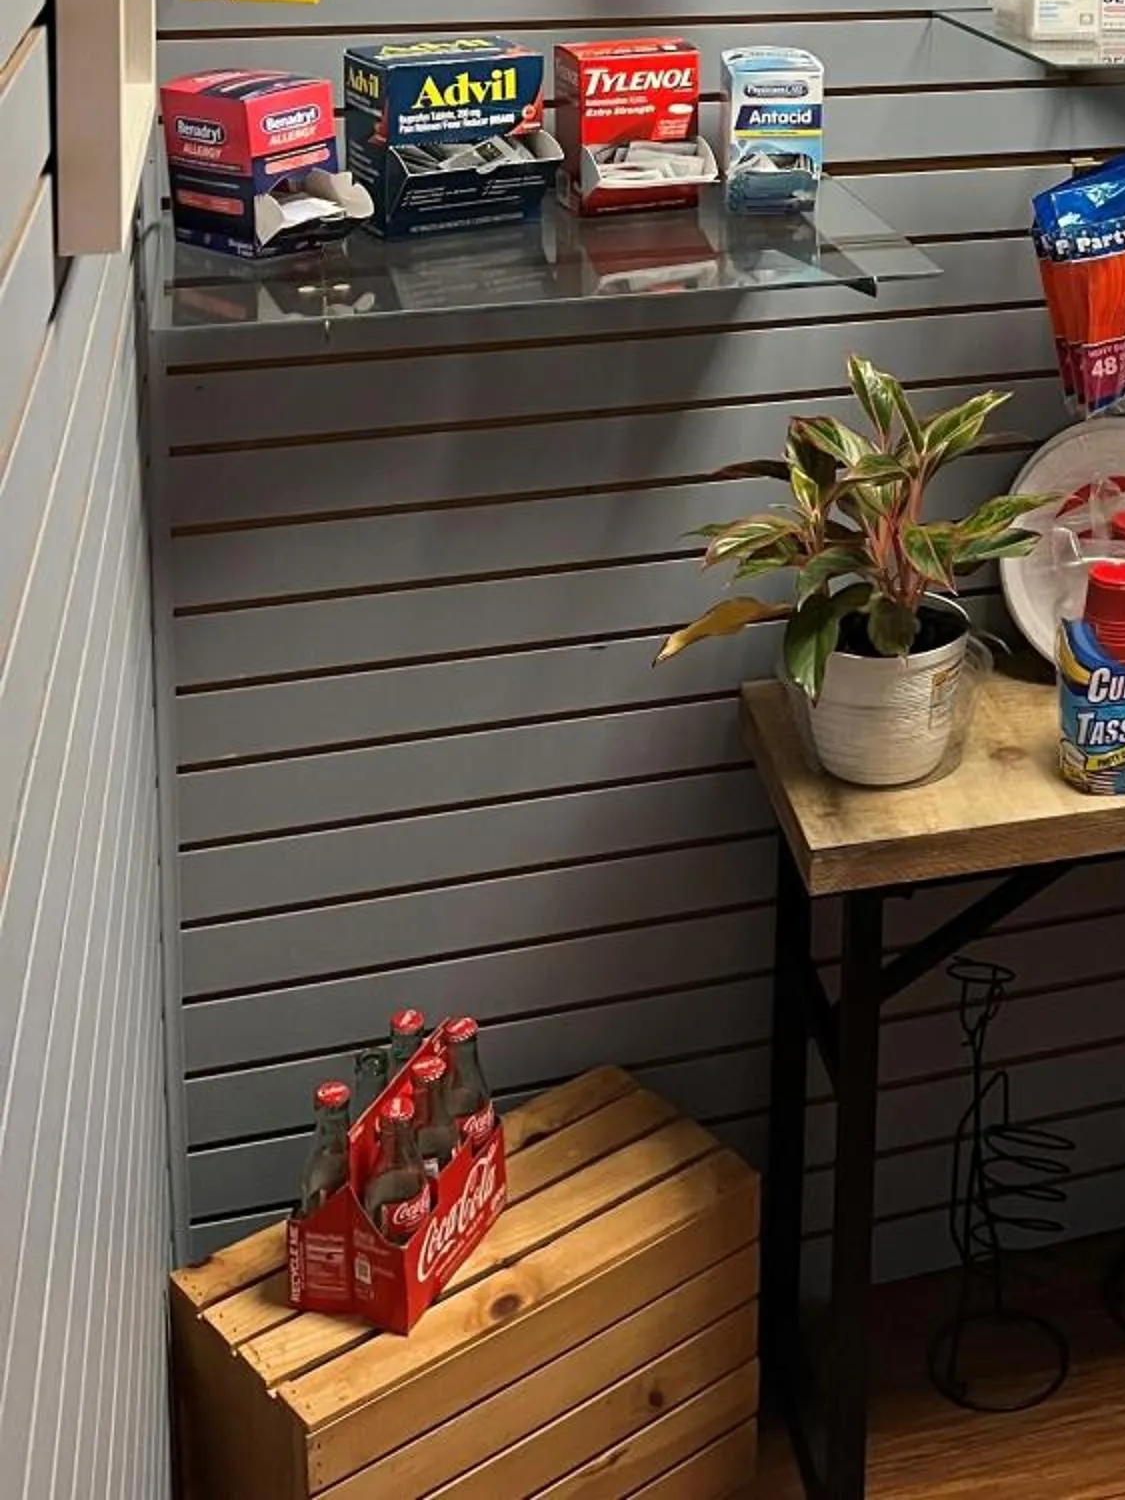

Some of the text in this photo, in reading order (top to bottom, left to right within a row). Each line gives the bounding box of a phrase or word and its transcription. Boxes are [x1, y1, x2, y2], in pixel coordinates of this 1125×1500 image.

[348, 67, 379, 98] Advil
[411, 68, 518, 109] Advil
[583, 67, 693, 97] TYLENOL
[266, 109, 316, 131] Benadryl
[749, 109, 812, 125] Antacid
[1092, 356, 1118, 377] 48
